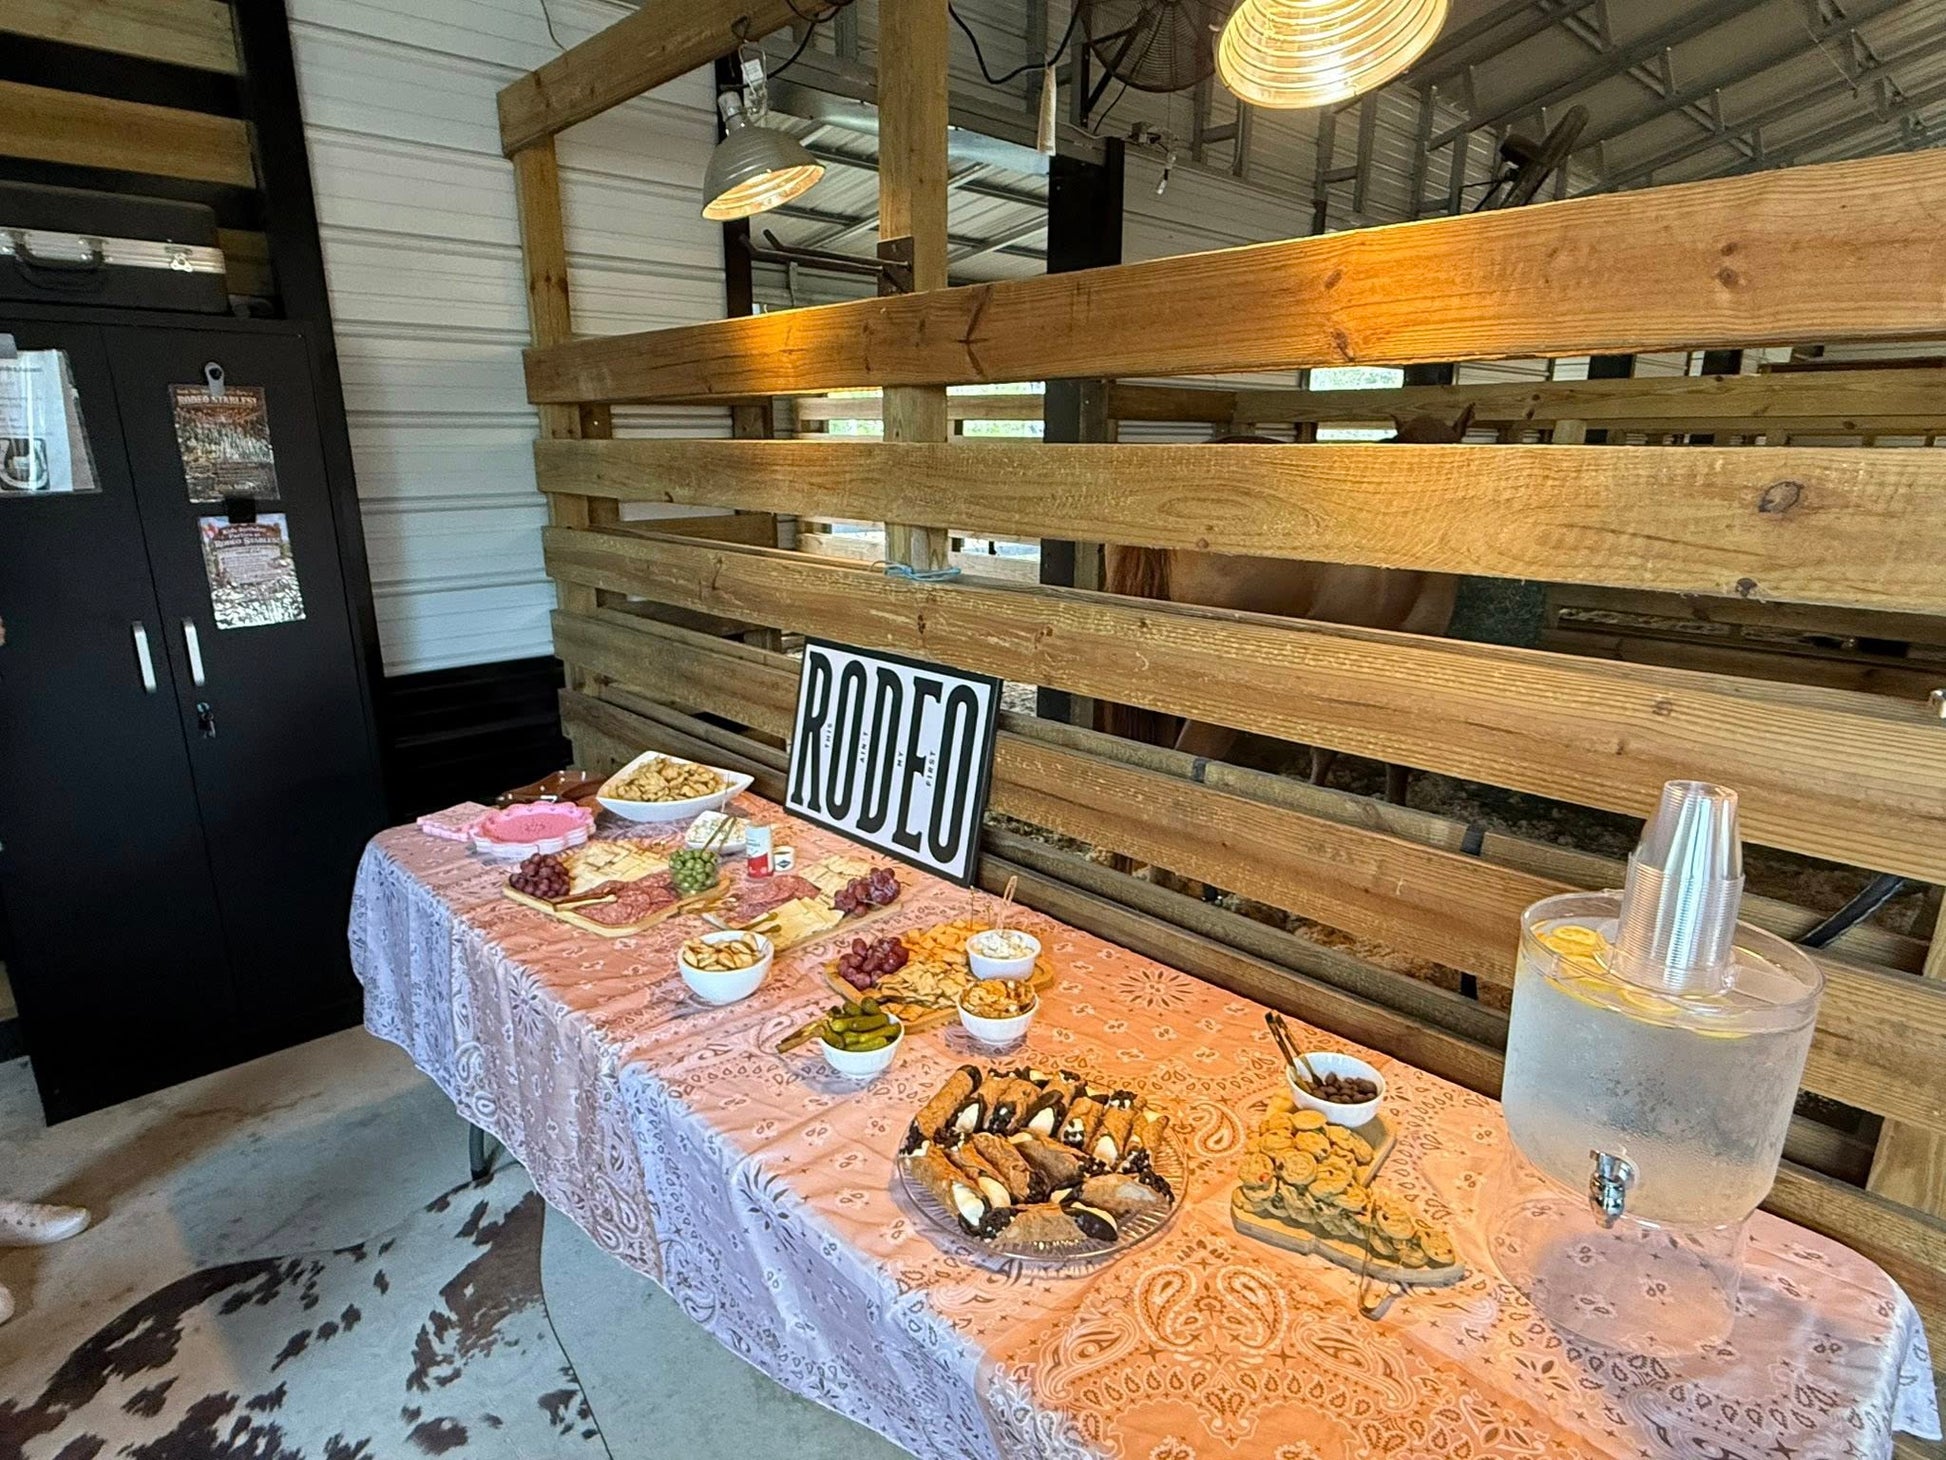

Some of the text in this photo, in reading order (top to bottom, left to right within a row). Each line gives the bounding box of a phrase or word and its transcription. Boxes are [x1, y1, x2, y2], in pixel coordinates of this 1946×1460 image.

[790, 651, 979, 864] RODEO
[825, 722, 936, 787] THIS AIN'T MY FIRST
